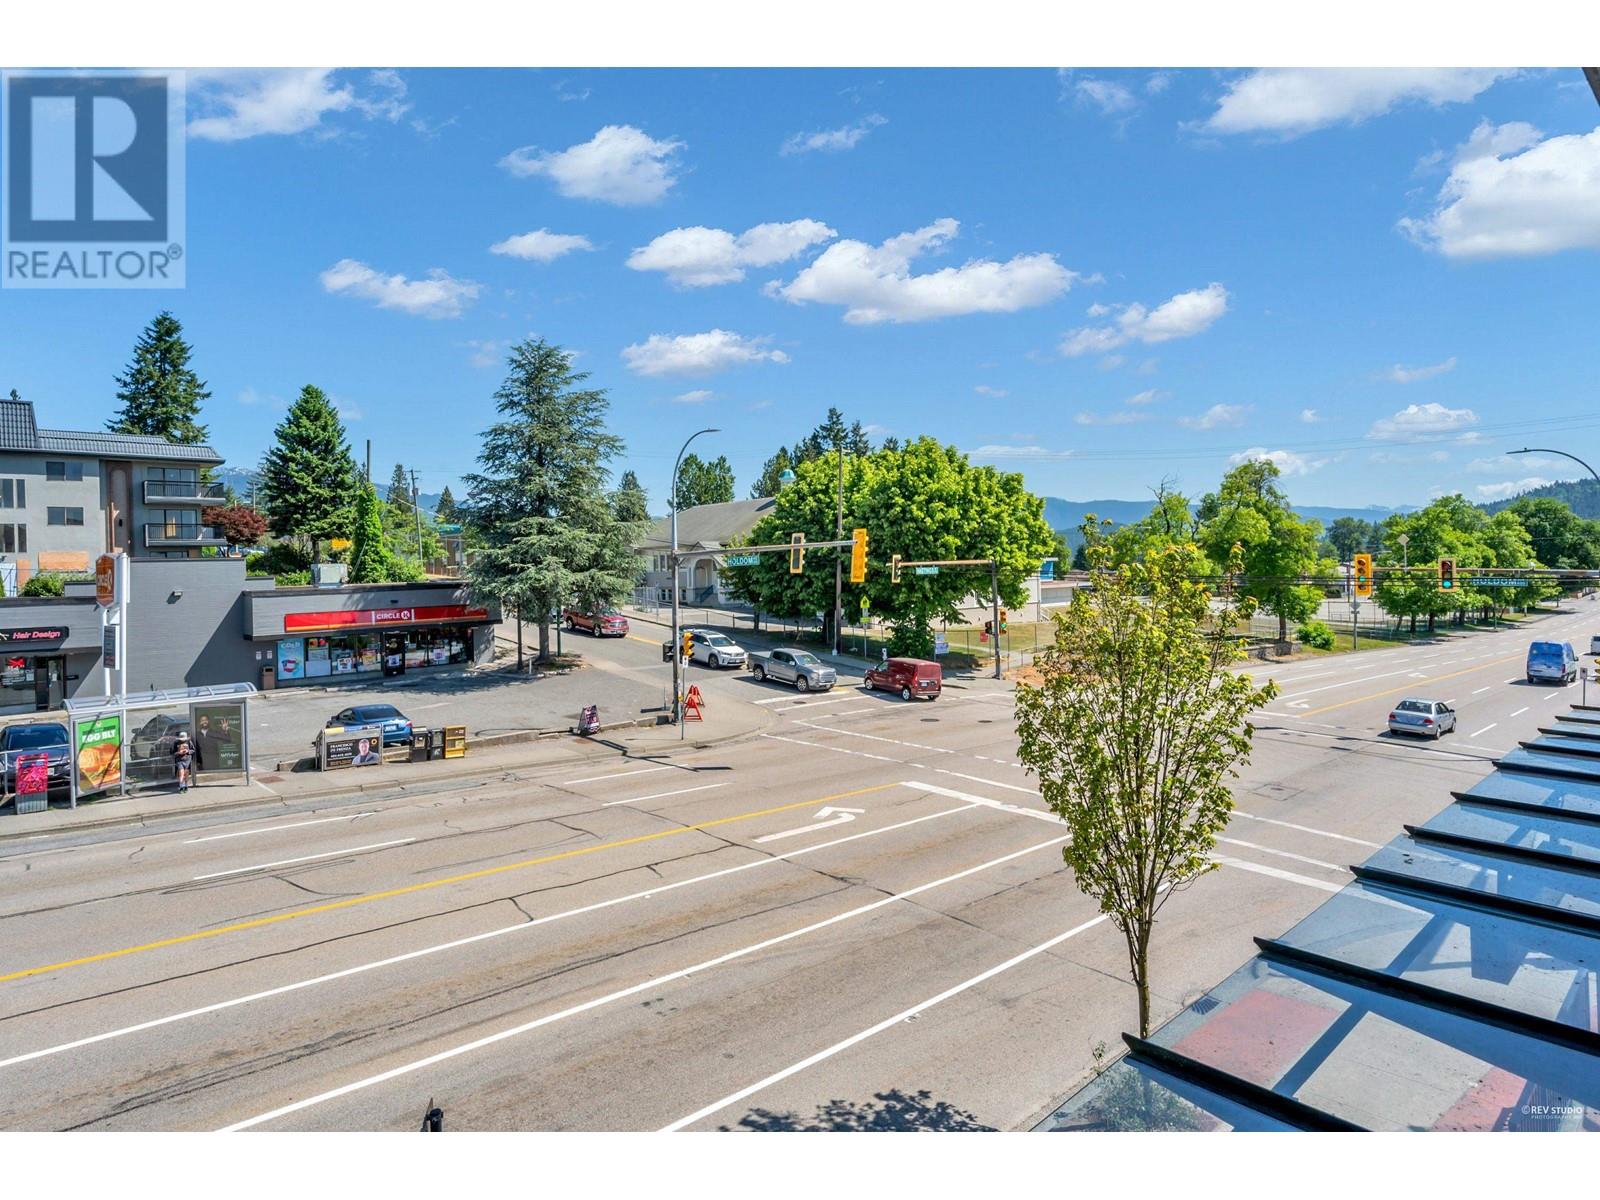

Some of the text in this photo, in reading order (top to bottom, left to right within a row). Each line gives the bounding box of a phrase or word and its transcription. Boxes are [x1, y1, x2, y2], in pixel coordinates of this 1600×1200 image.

[728, 556, 754, 566] HOLDOM
[1472, 578, 1517, 586] HOLDOM
[376, 612, 401, 620] CIRCLE
[12, 630, 61, 640] Hair Design
